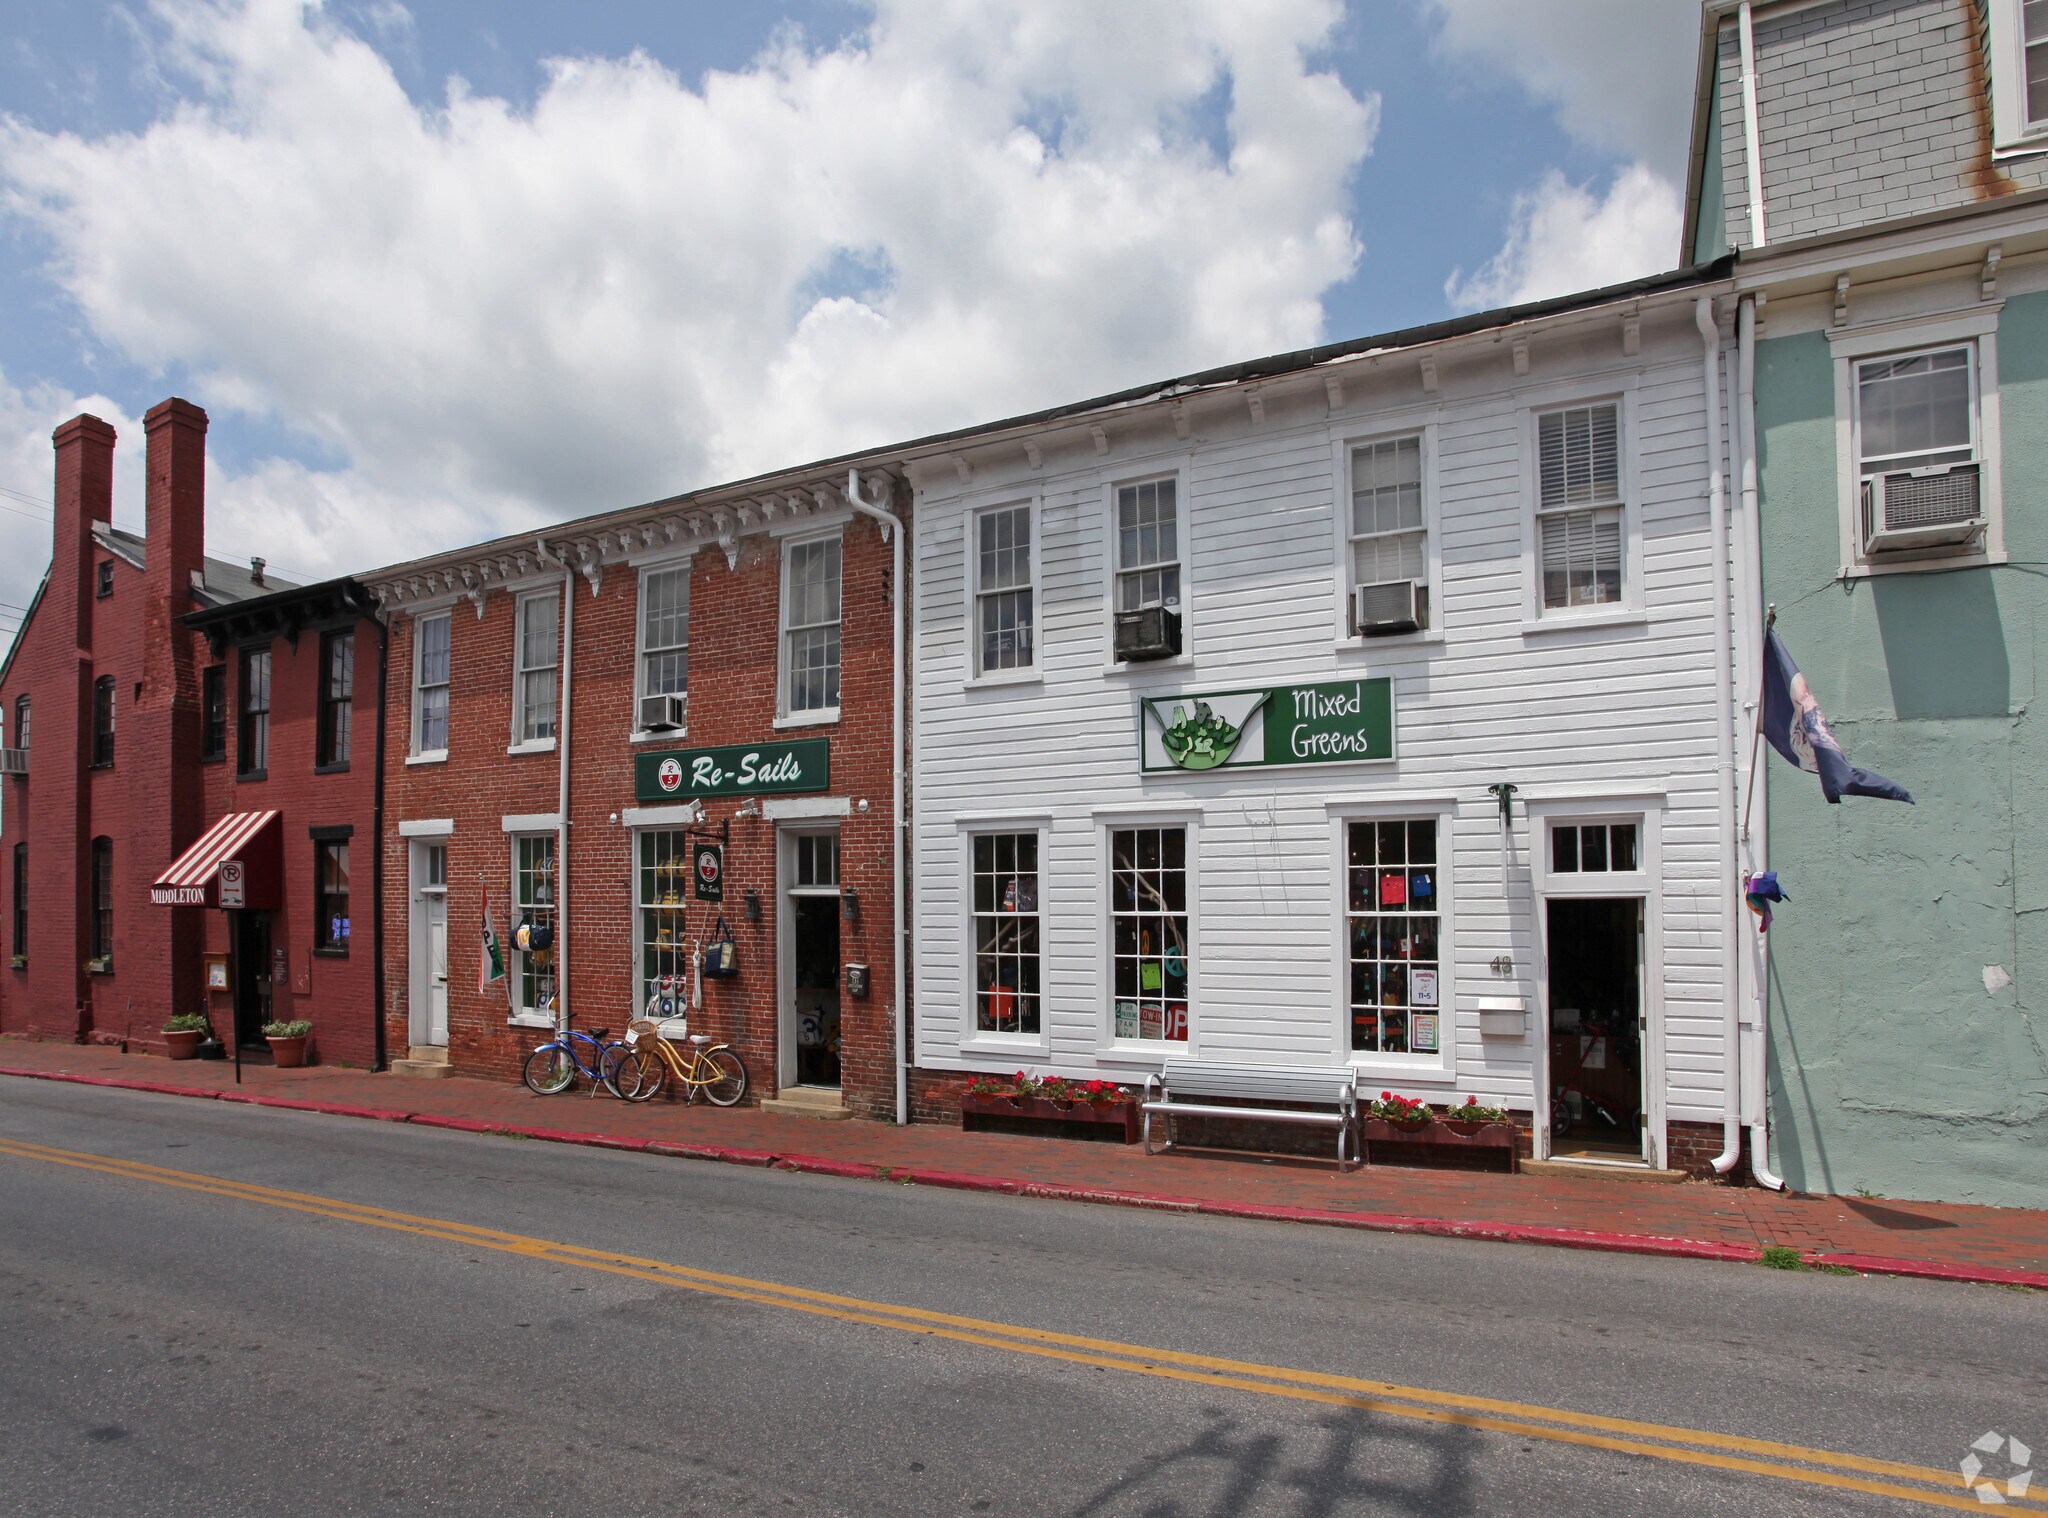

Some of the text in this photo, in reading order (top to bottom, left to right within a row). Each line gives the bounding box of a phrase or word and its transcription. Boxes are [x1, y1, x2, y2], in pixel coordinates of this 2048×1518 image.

[1291, 682, 1360, 719] Mixed
[1291, 723, 1367, 757] Greens
[691, 752, 802, 788] Re-Sails
[150, 888, 205, 904] MIDDLETON
[1490, 955, 1512, 973] 48
